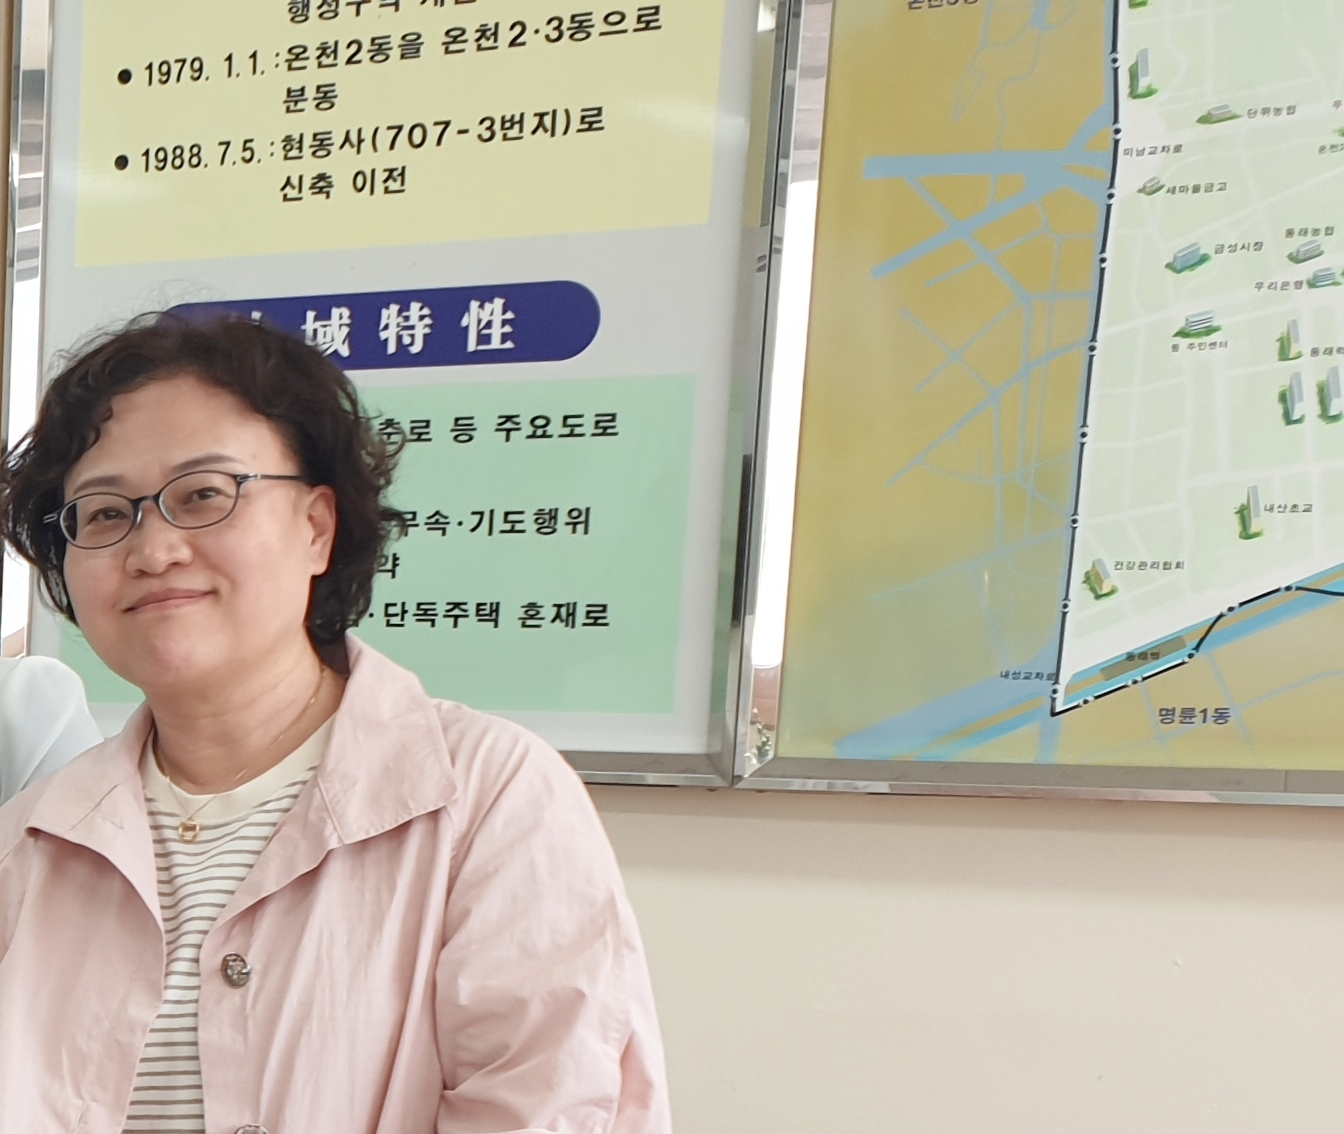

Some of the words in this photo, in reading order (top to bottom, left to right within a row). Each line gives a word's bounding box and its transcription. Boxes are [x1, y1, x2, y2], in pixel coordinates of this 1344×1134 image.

[143, 55, 211, 88] 1979.
[282, 82, 339, 115] 분동
[1246, 104, 1297, 119] 단위농협
[140, 145, 209, 173] 1988.
[279, 168, 335, 203] 신축
[351, 164, 408, 197] 이전
[1165, 181, 1228, 195] 새마을금고
[1213, 241, 1264, 255] 금성시장
[1254, 279, 1304, 292] 우리은행
[449, 416, 477, 443] 등
[494, 411, 620, 443] 주요도로
[1113, 559, 1186, 571] 건강관리협회
[517, 601, 611, 630] 혼재로
[1158, 706, 1231, 725] 명륜1동
